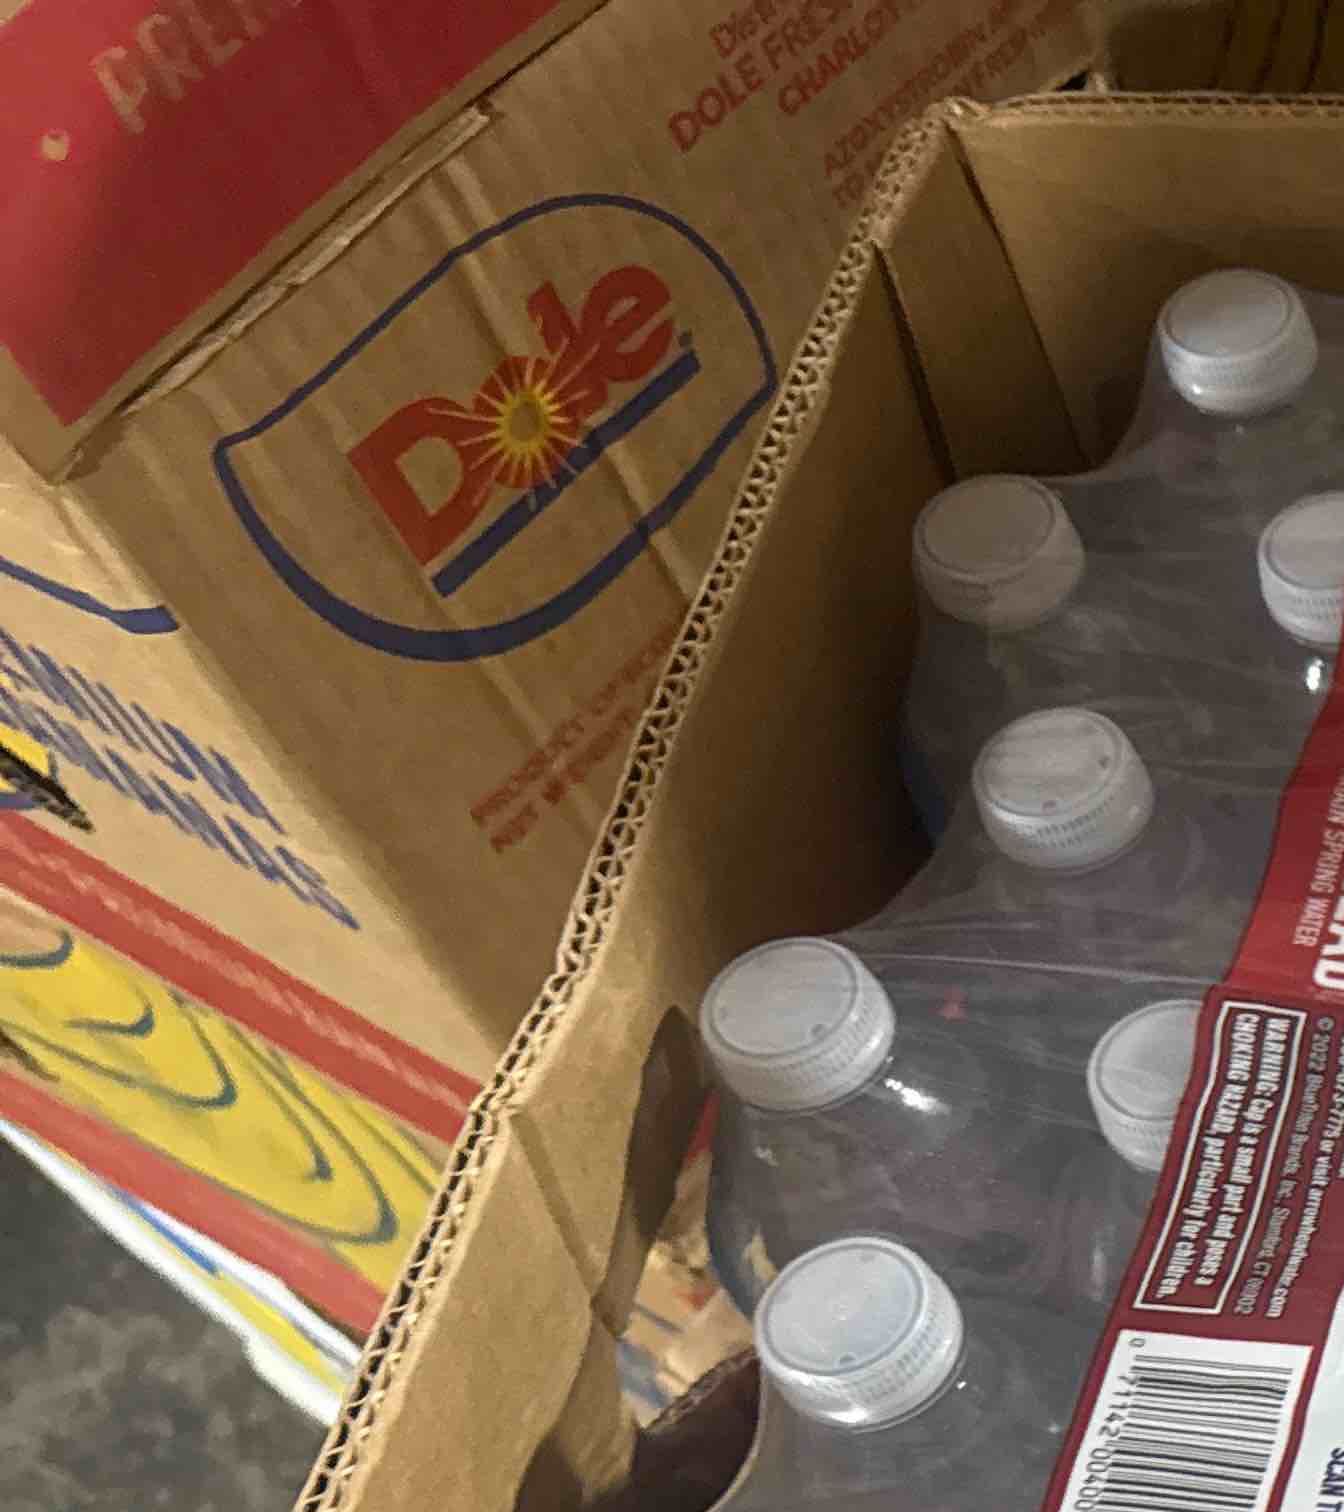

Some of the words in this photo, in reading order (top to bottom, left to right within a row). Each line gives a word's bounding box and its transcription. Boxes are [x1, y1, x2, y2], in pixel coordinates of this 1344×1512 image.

[668, 53, 764, 150] DOLE
[348, 266, 676, 564] Dole
[1291, 895, 1330, 948] WATER
[1225, 1011, 1262, 1082] CHOKING
[1251, 1016, 1292, 1098] WARNING:
[1182, 1136, 1231, 1218] particularly
[1226, 1146, 1261, 1184] small
[1177, 1218, 1206, 1239] for
[1194, 1238, 1228, 1276] poses
[1209, 1213, 1240, 1240] and
[1072, 1446, 1114, 1512] 00400
